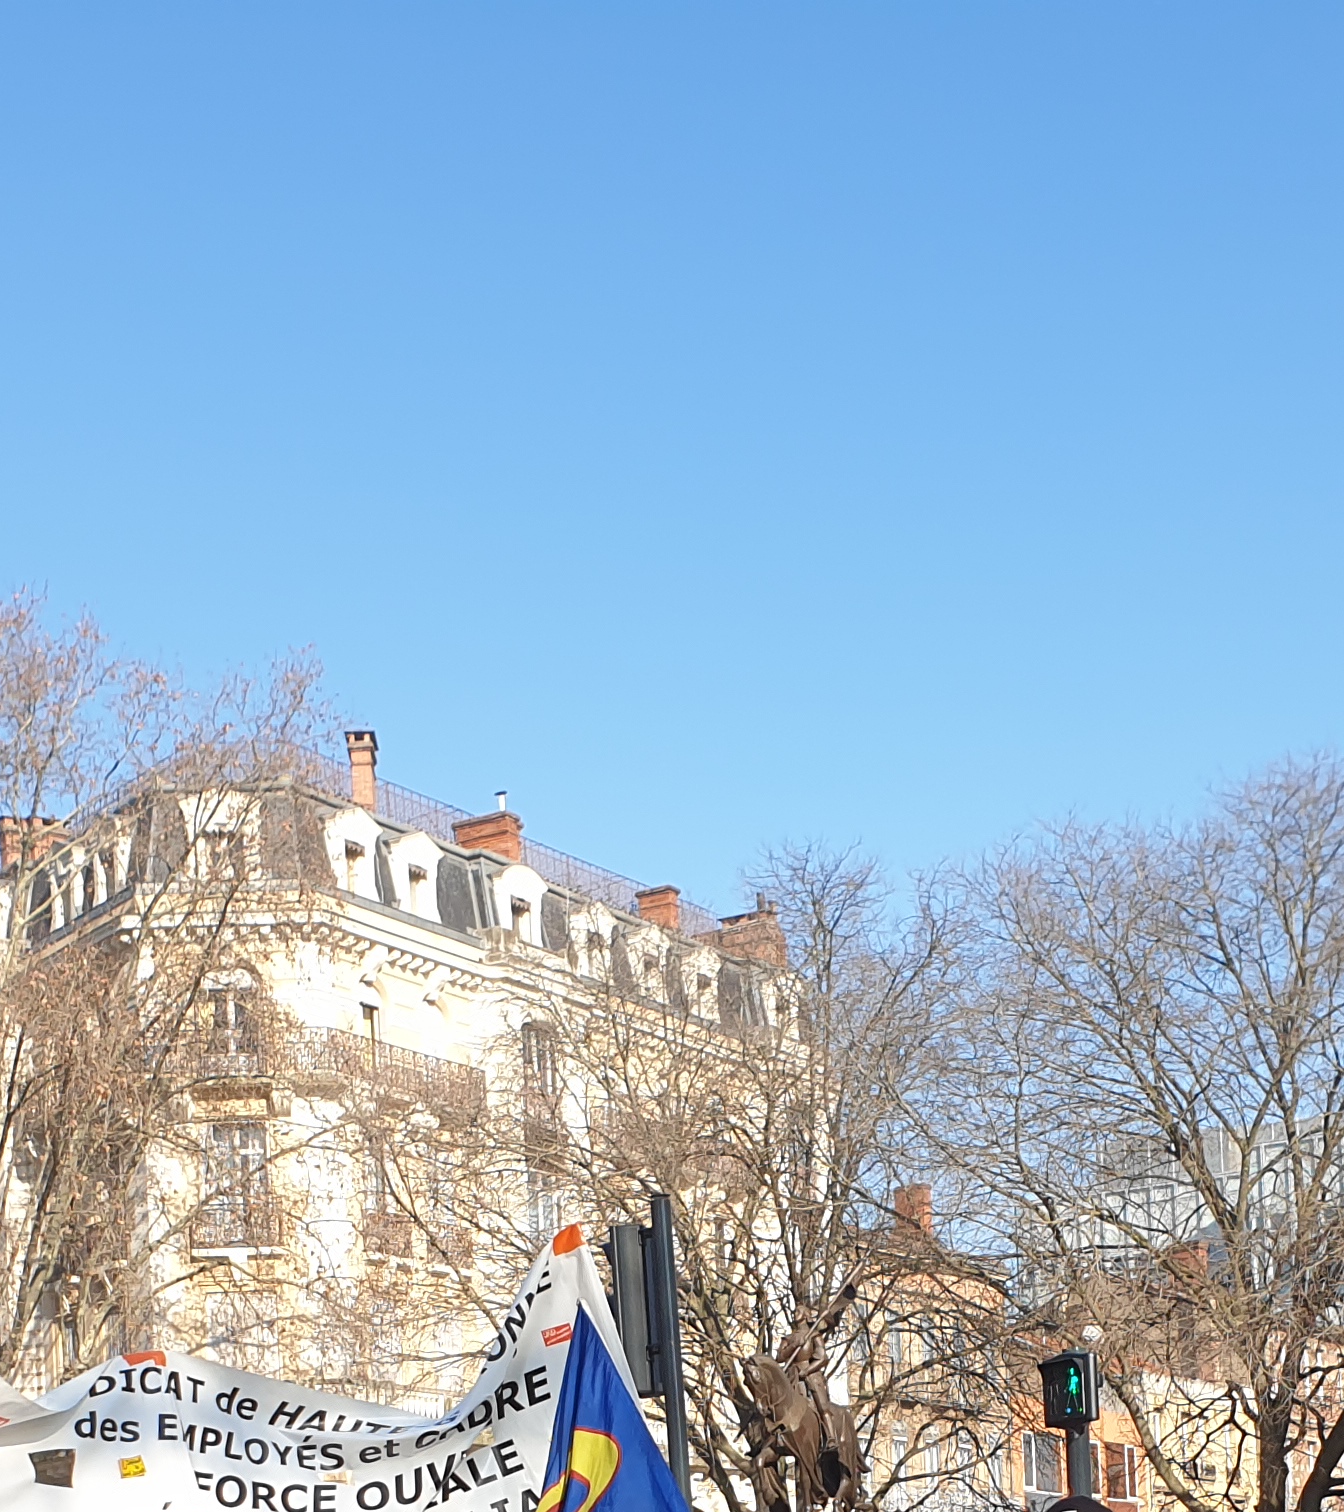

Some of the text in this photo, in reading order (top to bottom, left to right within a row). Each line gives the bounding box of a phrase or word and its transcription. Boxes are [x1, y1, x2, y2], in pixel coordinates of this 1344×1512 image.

[215, 1386, 258, 1421] de
[74, 1411, 141, 1443] des
[358, 1439, 401, 1464] et
